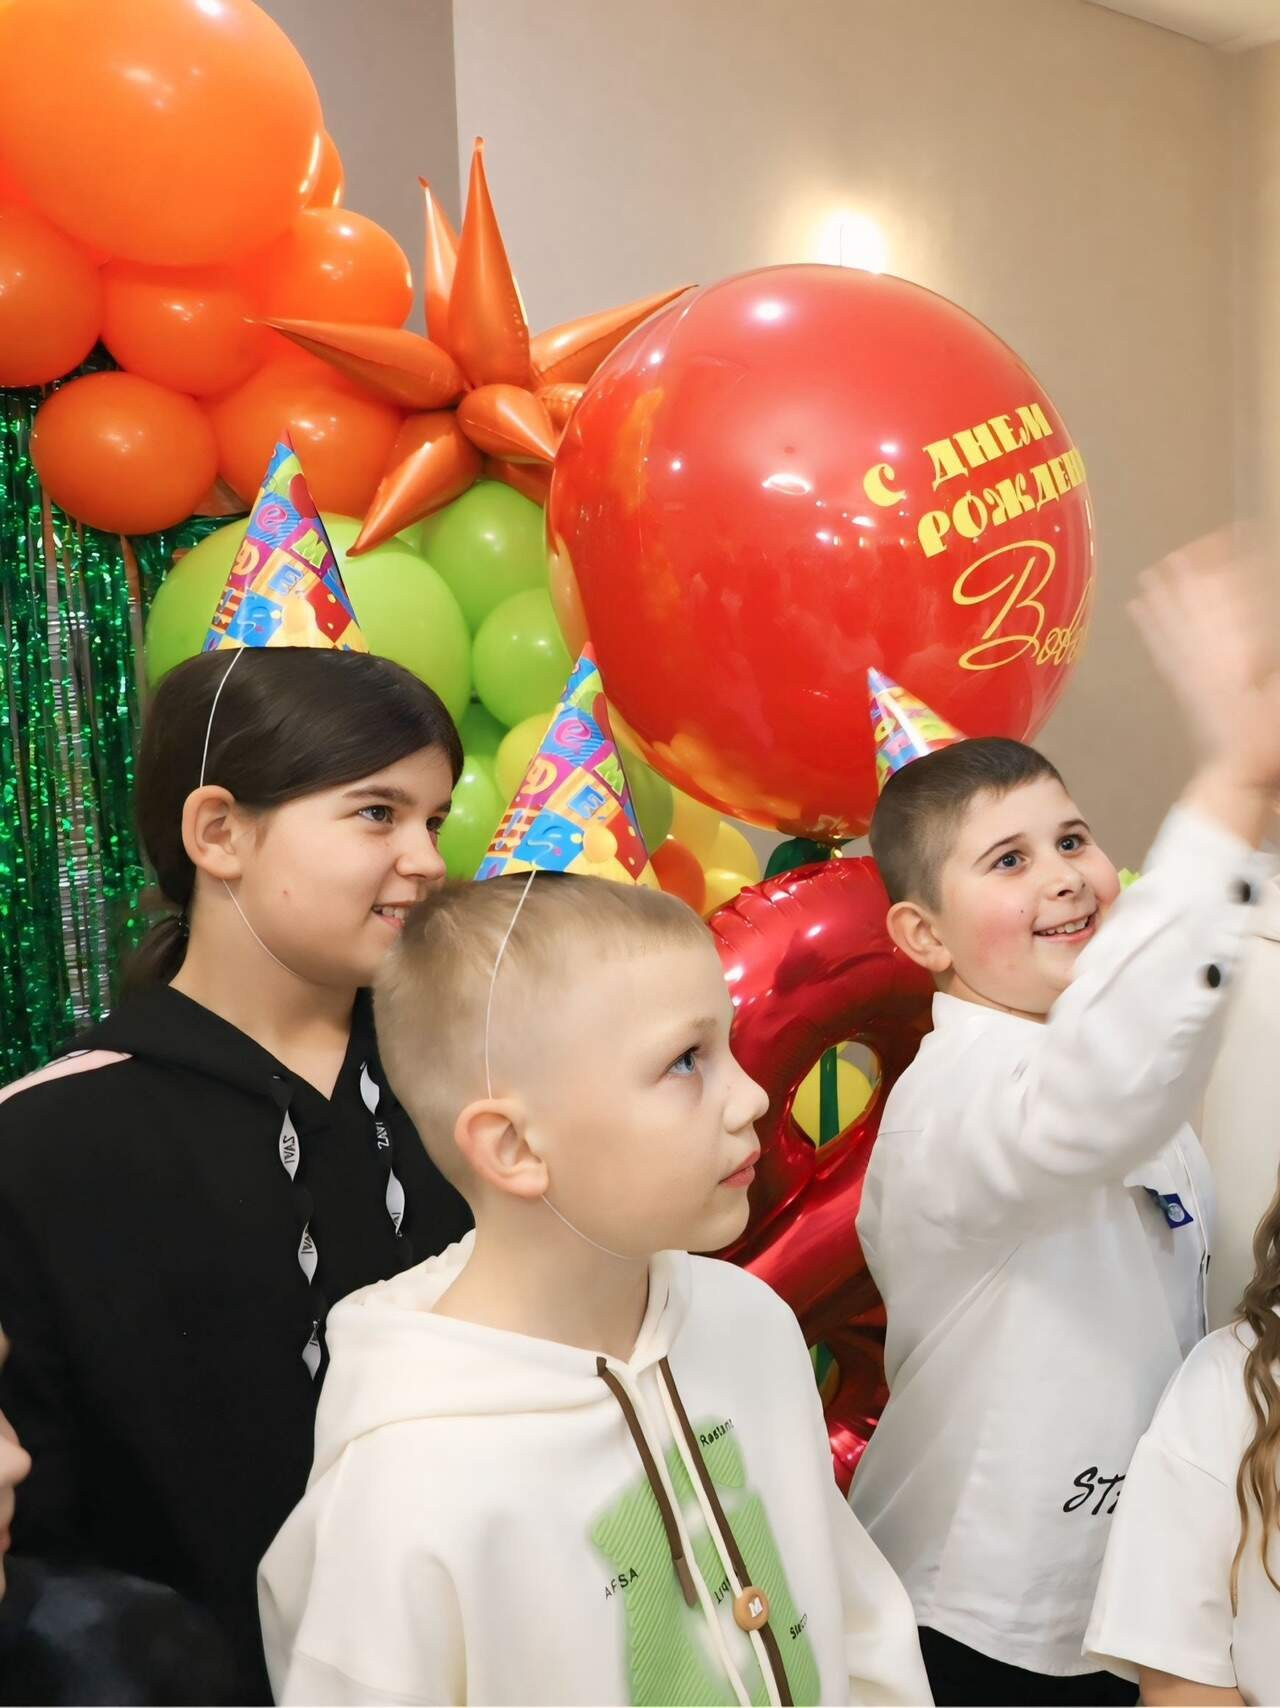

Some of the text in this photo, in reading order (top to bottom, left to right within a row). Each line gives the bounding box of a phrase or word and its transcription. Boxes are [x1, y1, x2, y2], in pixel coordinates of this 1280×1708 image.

[863, 403, 1053, 507] С ДНЕМ
[604, 1566, 639, 1600] AFSA
